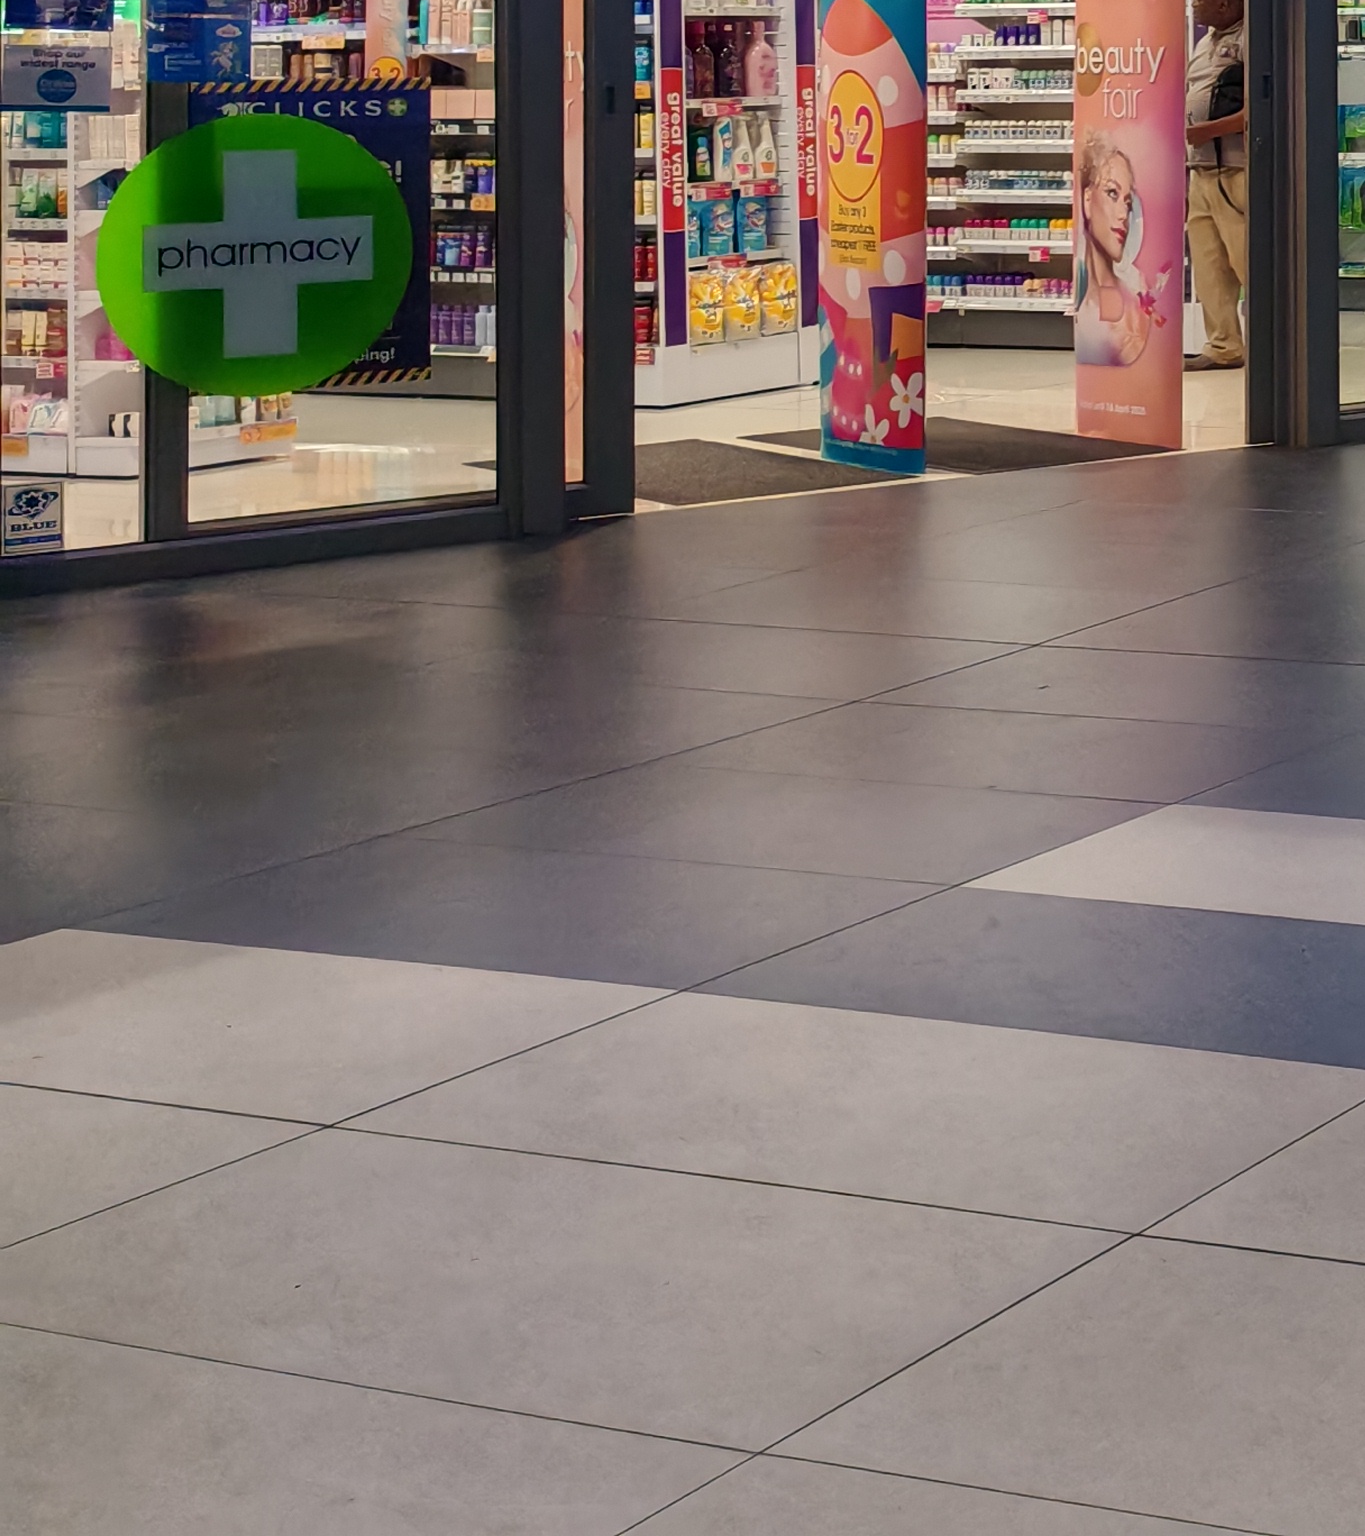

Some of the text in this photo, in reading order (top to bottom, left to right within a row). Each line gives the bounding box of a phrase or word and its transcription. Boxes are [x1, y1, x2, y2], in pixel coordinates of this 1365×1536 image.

[61, 61, 96, 72] range
[1077, 37, 1166, 83] beauty
[249, 99, 382, 118] CLICKS
[1102, 78, 1143, 119] fair
[660, 111, 673, 189] every day
[667, 92, 684, 208] great value
[802, 87, 816, 197] great value
[828, 104, 874, 165] 3 2
[156, 235, 361, 277] pharmacy
[10, 520, 57, 532] BLUE
